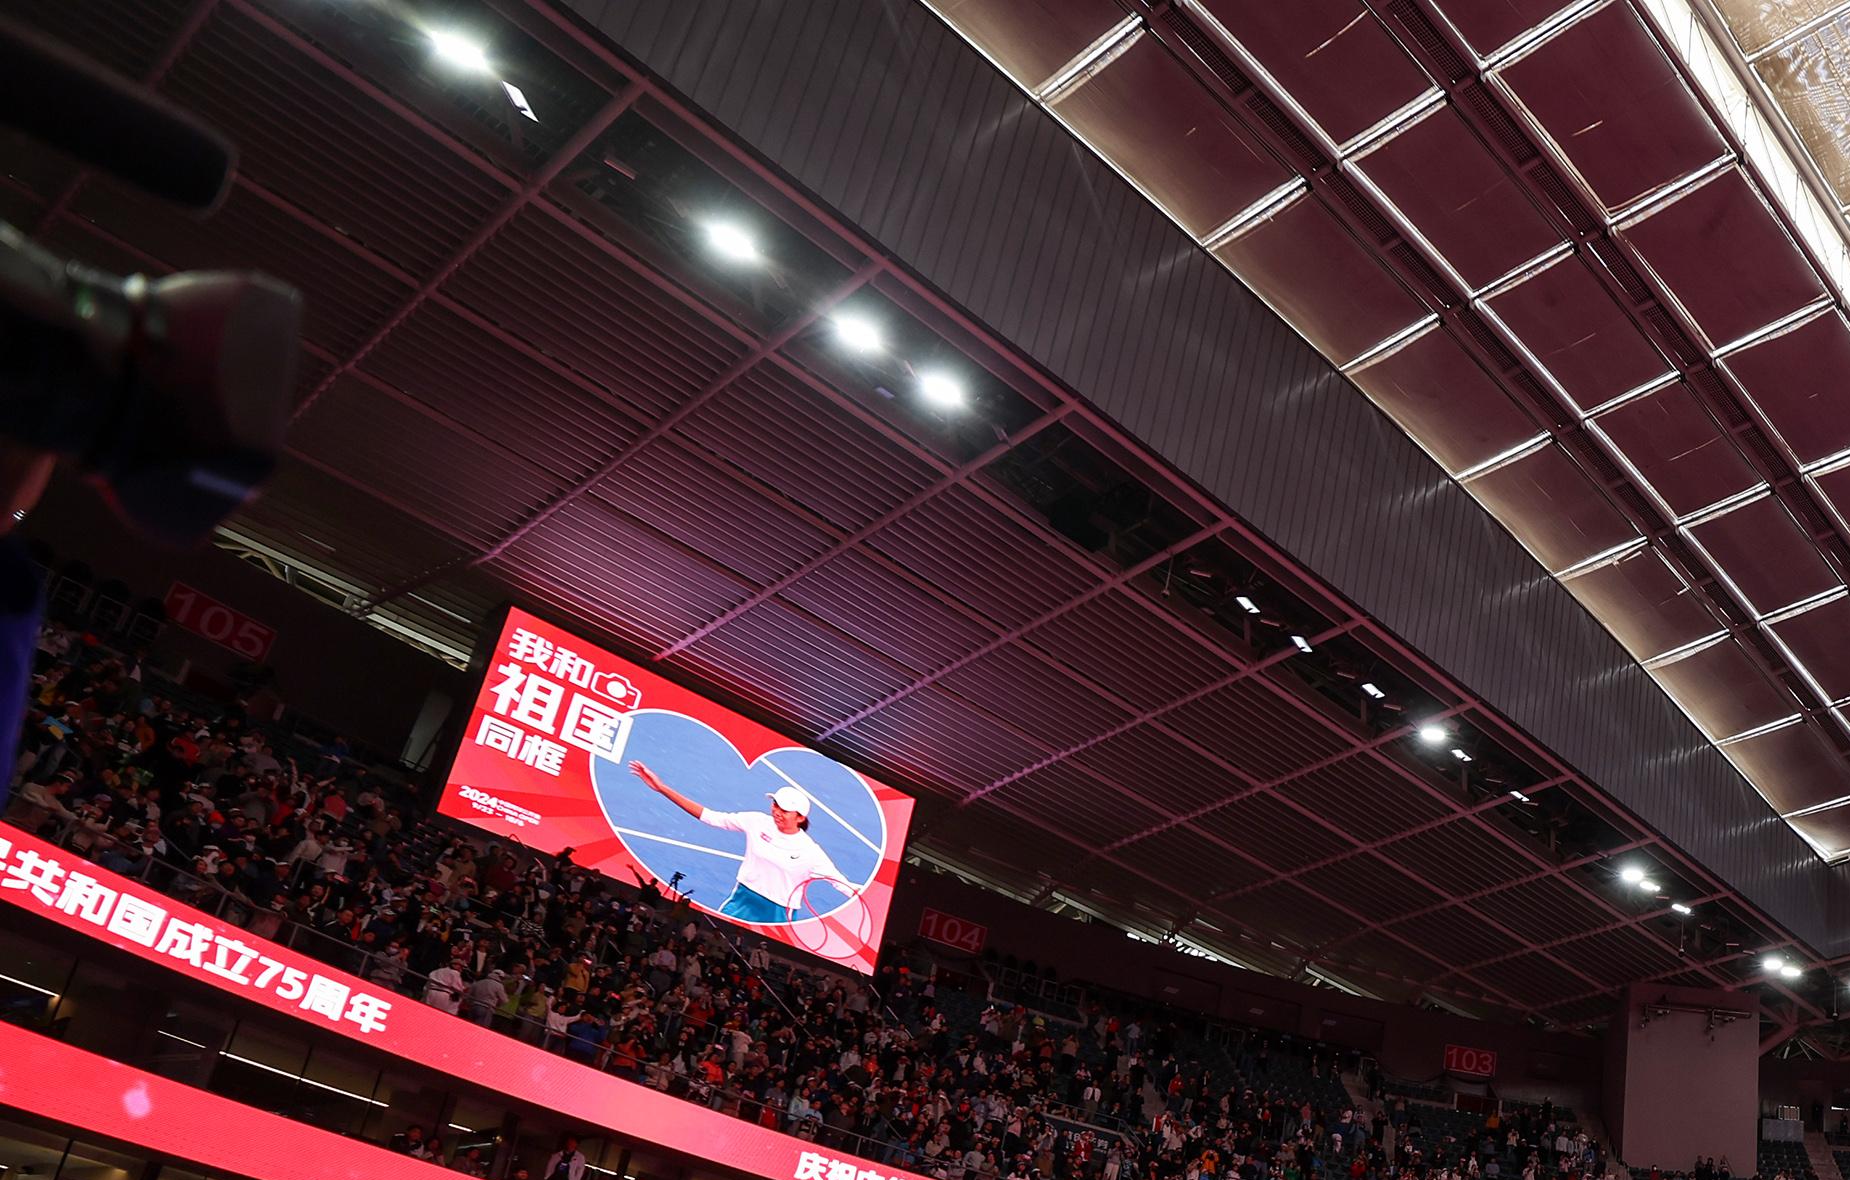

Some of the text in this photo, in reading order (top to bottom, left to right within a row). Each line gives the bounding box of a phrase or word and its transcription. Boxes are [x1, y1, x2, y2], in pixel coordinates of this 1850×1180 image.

[172, 586, 268, 652] 105
[508, 627, 595, 689] 我和
[489, 662, 634, 765] 祖国
[475, 714, 568, 777] 同框
[459, 785, 497, 808] 2024
[925, 916, 981, 950] 104
[1446, 1047, 1494, 1075] 103
